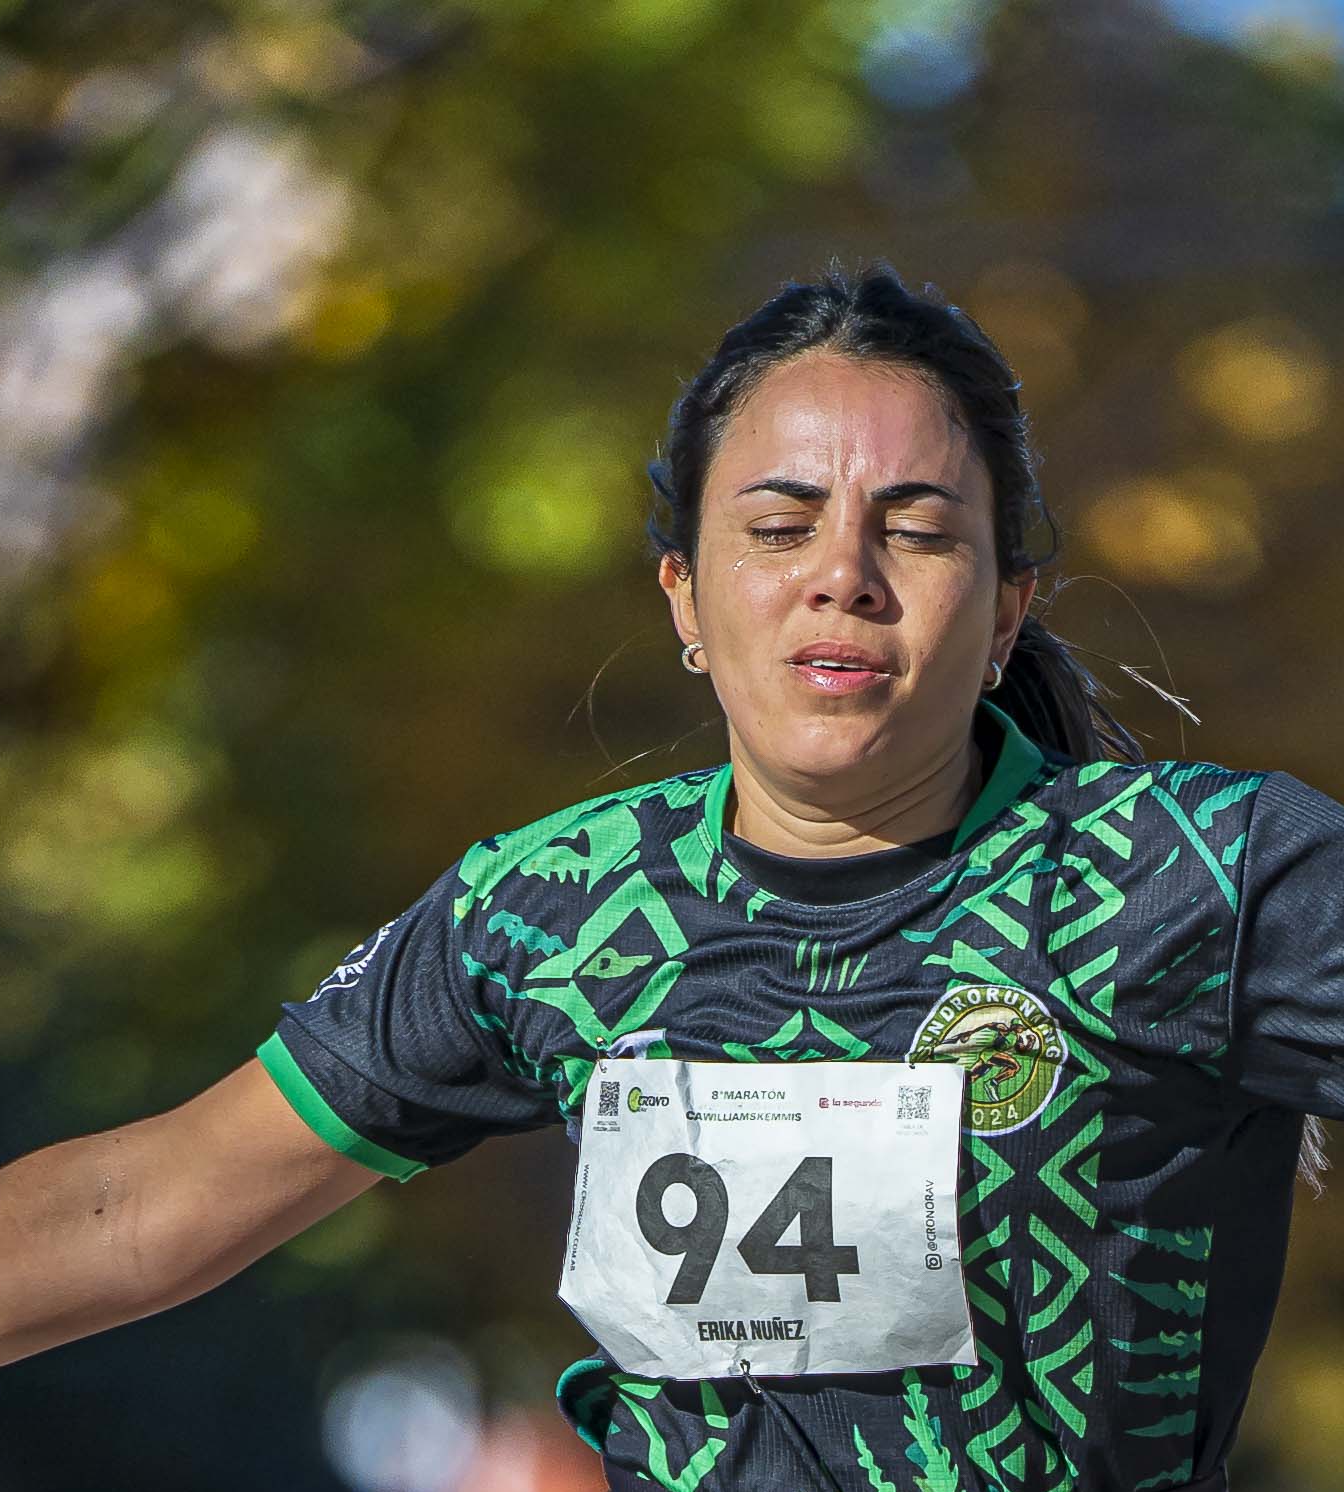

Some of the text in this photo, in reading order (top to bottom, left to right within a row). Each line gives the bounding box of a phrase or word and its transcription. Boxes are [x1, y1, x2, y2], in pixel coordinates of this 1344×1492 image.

[962, 1103, 1019, 1126] 024
[636, 1152, 861, 1305] 94
[924, 1179, 938, 1252] @CRONORAV
[697, 1316, 806, 1341] ERIKA NUÑEZ
